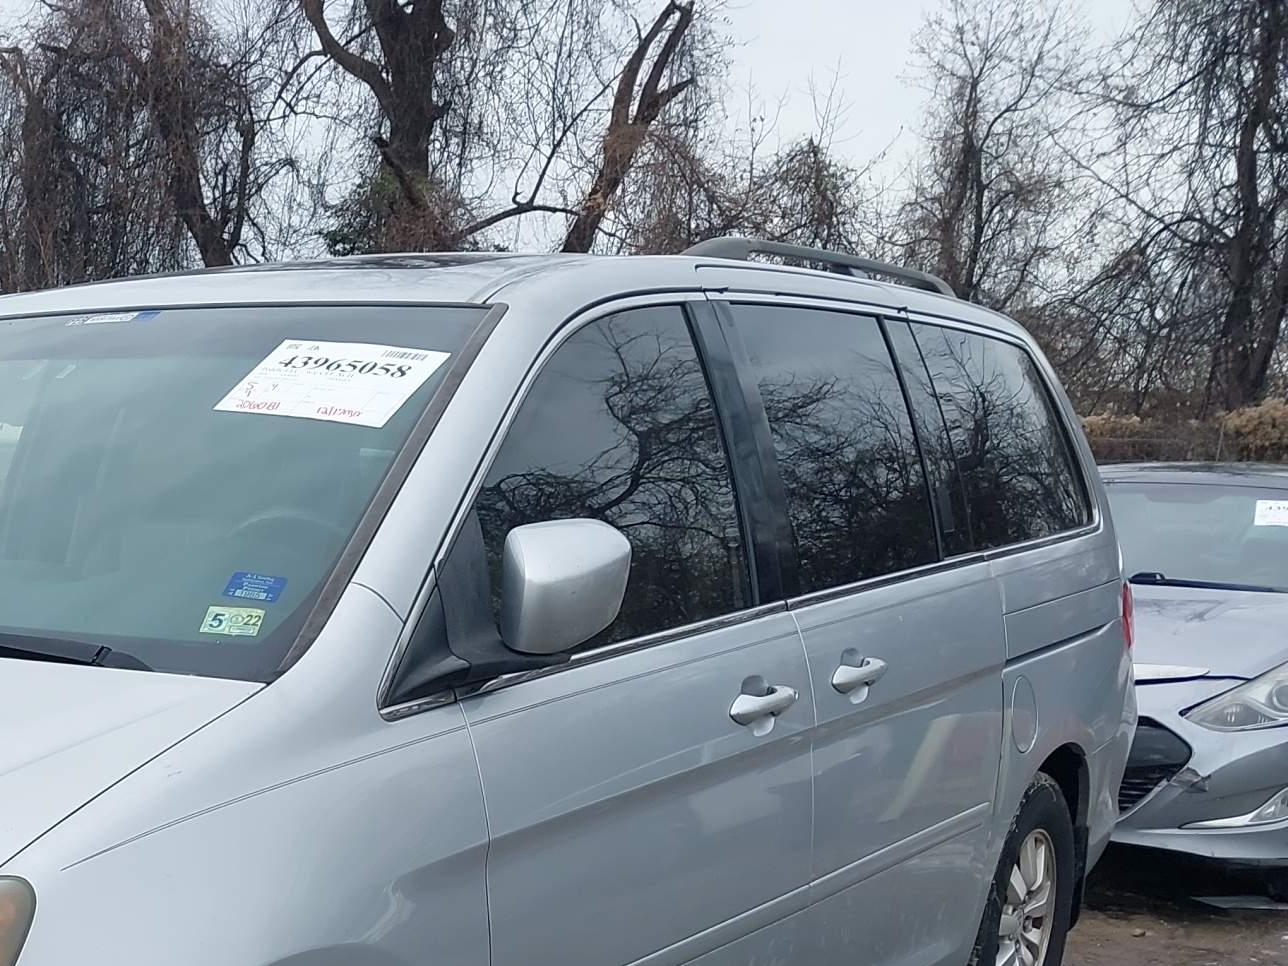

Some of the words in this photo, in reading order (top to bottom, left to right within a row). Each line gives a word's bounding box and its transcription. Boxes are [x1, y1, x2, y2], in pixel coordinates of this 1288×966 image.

[278, 355, 412, 378] 43965058
[209, 613, 226, 628] 5
[244, 614, 262, 626] 22
